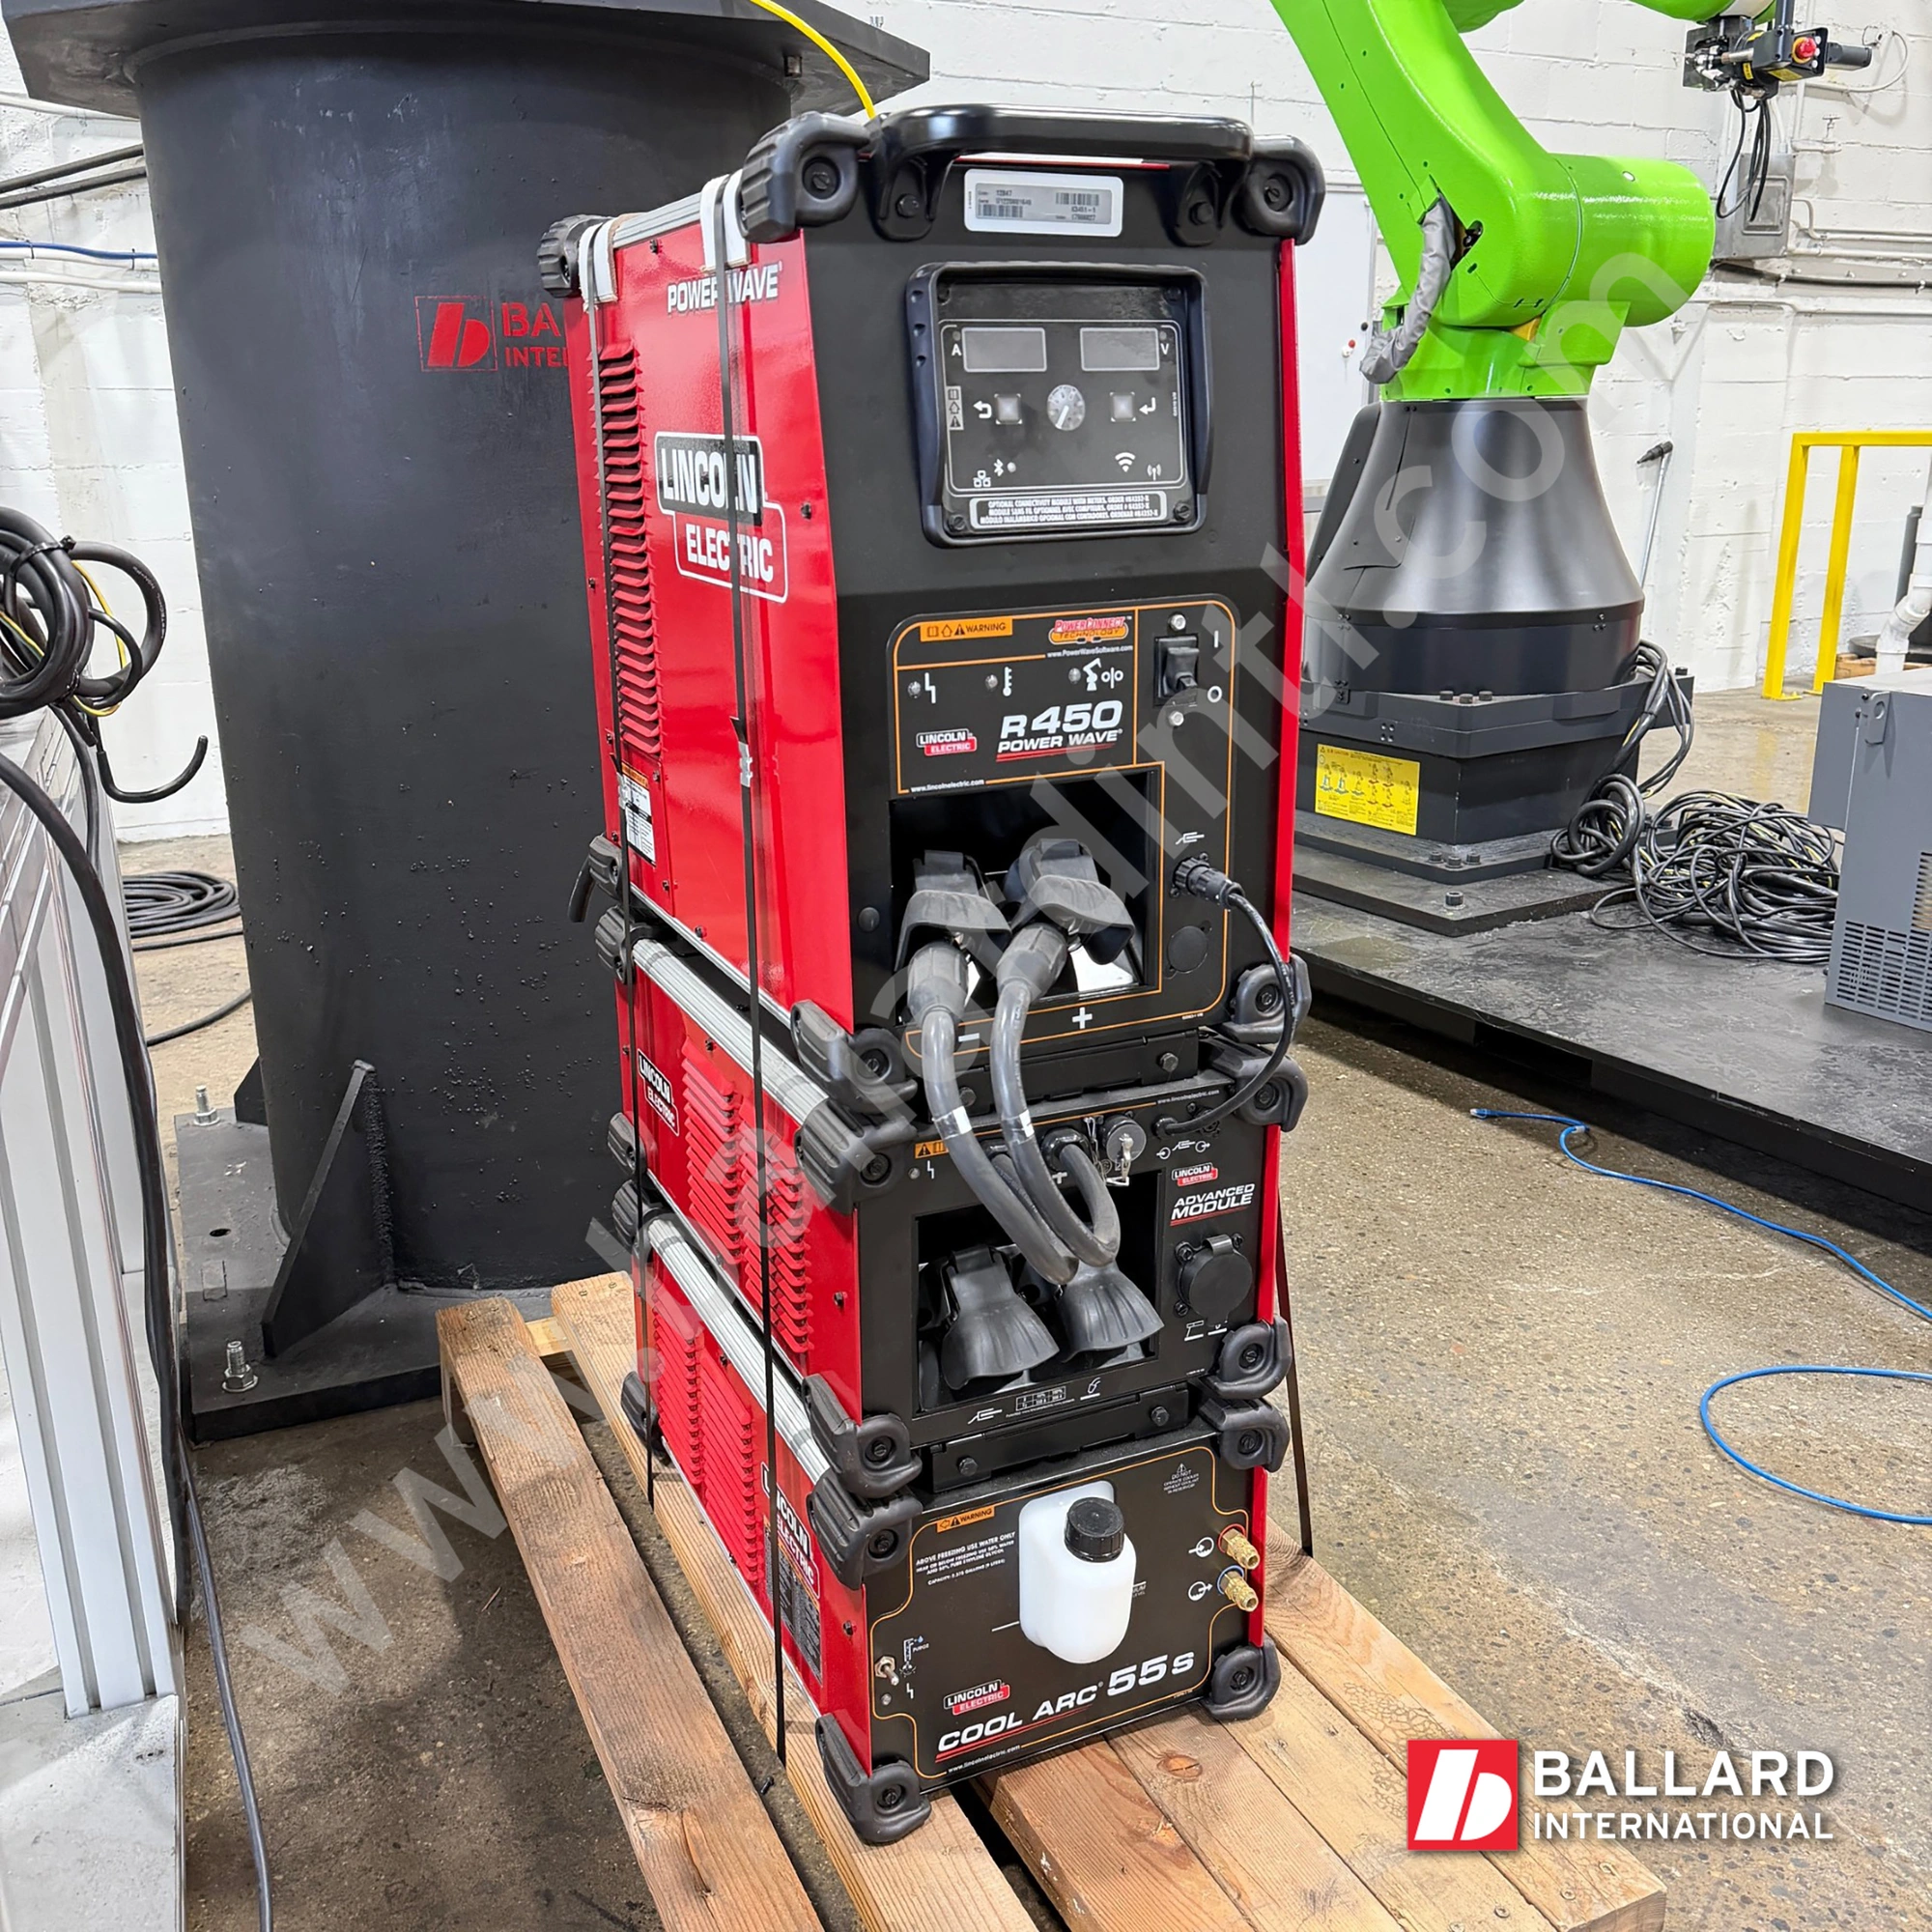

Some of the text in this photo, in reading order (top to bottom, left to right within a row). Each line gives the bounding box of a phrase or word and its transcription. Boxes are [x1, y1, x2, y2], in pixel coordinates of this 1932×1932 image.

[952, 343, 962, 356] A
[1160, 343, 1169, 355] V
[686, 523, 774, 582] ELECRIC
[966, 622, 1006, 633] WARNING
[1000, 700, 1123, 739] R450
[920, 731, 966, 745] LINCOLN
[930, 742, 971, 753] ELECTRIC
[998, 735, 1063, 753] POWER
[911, 779, 984, 792] www.lincolnelectric.com
[639, 1055, 671, 1104] LINCOLN
[647, 1088, 676, 1128] ELECTRIC
[1174, 1165, 1210, 1179] LINCOLN
[1171, 1192, 1253, 1220] MODULE
[1174, 1183, 1255, 1208] ADVANCED
[959, 1508, 992, 1522] WARNING
[916, 1531, 1016, 1566] ABOVE FREEZING USE WATER ONLY
[948, 1682, 998, 1707] LINCOLN
[959, 1690, 1004, 1711] ELECTRIC
[938, 1712, 1023, 1752] COOL
[1033, 1685, 1098, 1720] ARC
[948, 1745, 1020, 1774] www.lincolnelectric.com
